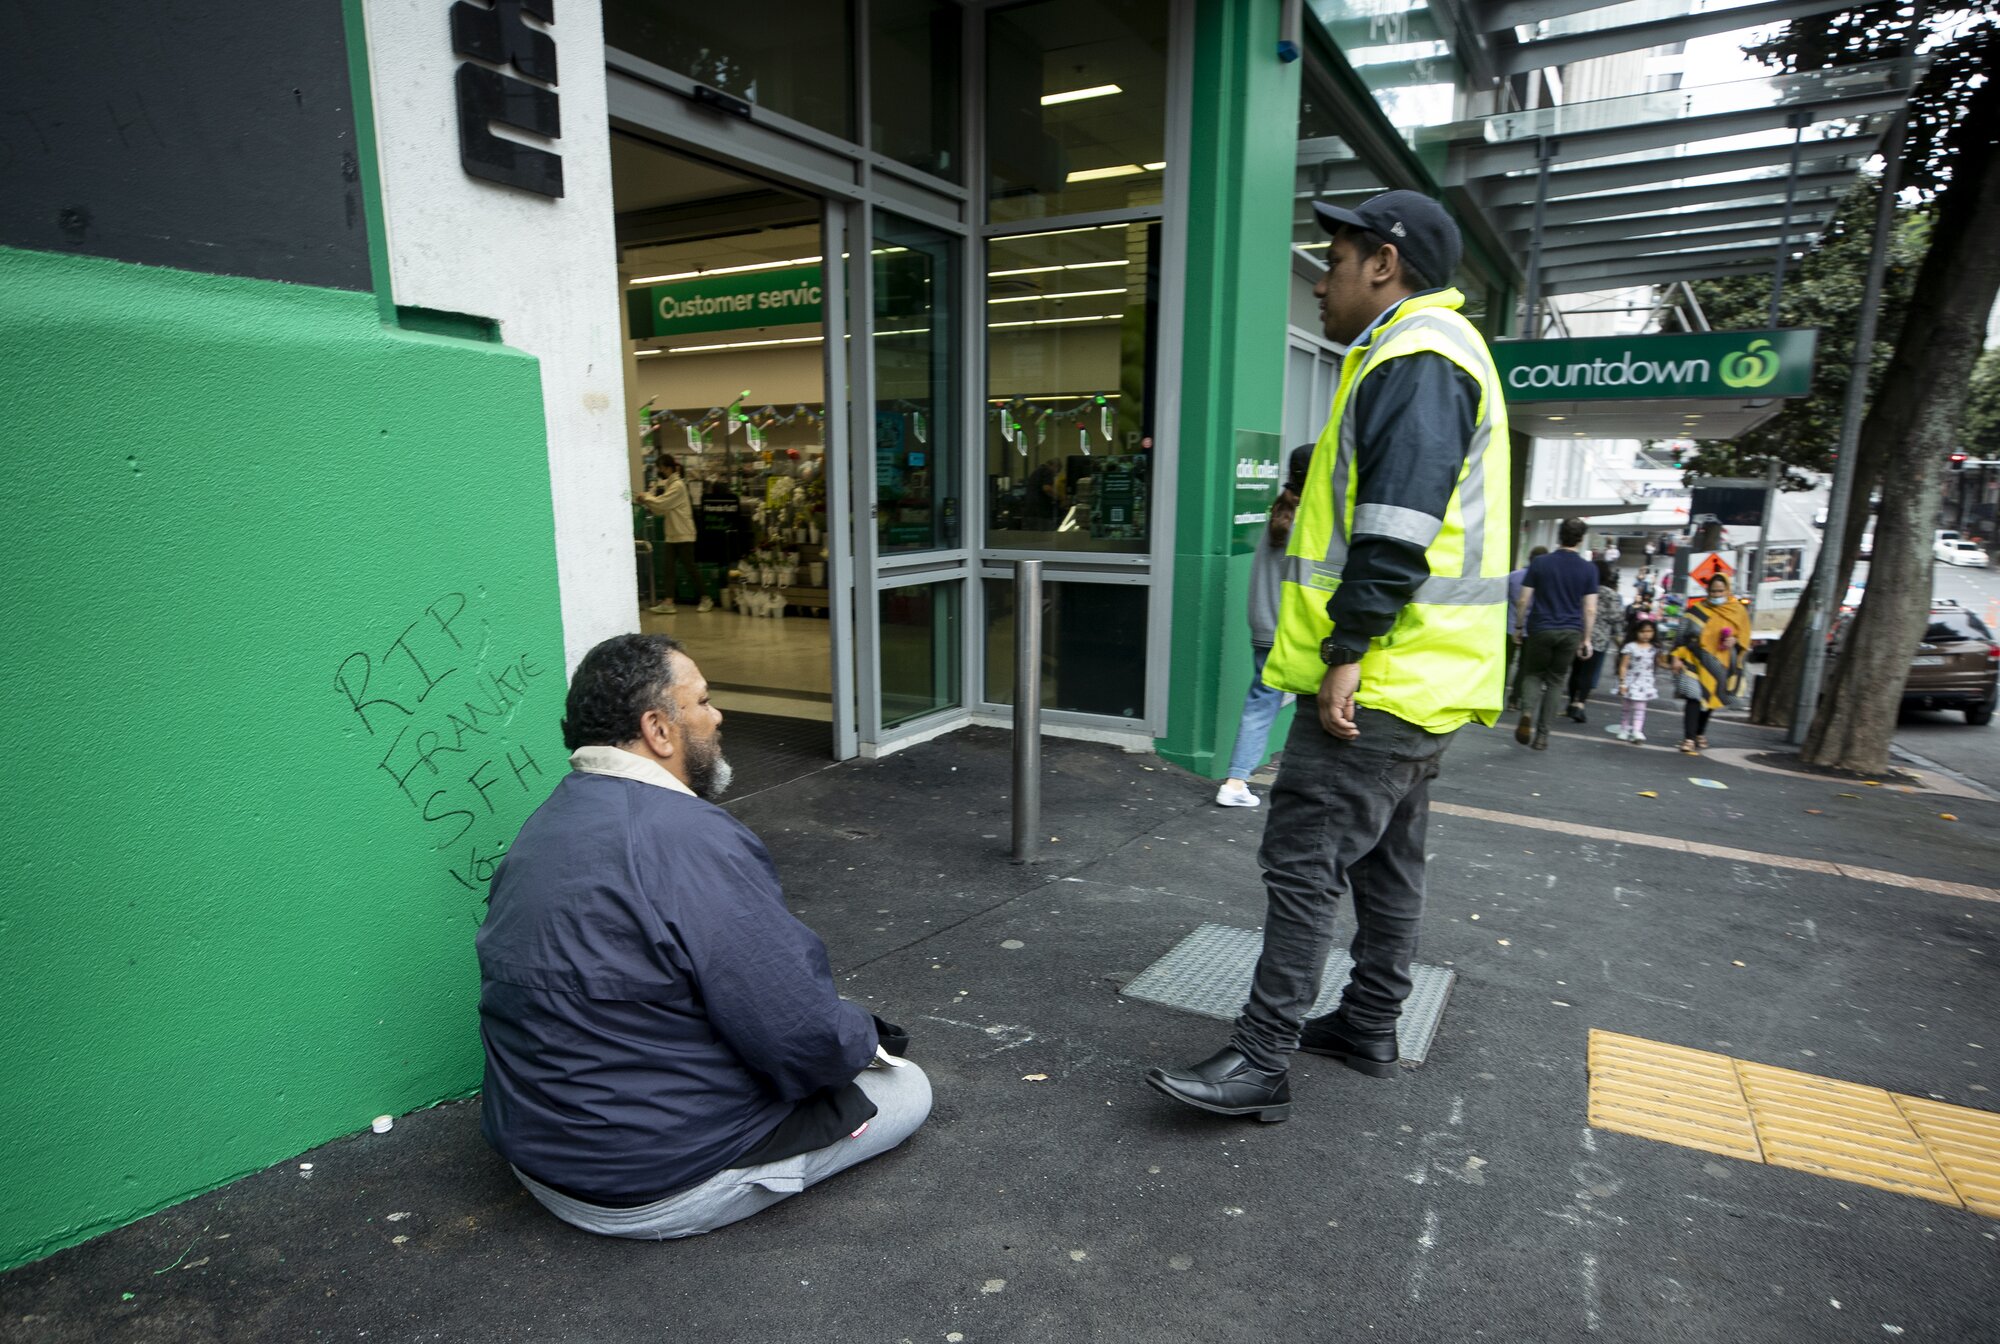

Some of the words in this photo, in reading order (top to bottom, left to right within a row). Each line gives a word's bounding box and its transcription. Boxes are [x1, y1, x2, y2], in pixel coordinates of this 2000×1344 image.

[659, 291, 755, 319] Customer
[758, 281, 822, 309] servic
[1508, 351, 1710, 388] countdown
[334, 592, 466, 736] RIP
[423, 745, 543, 850] SFH
